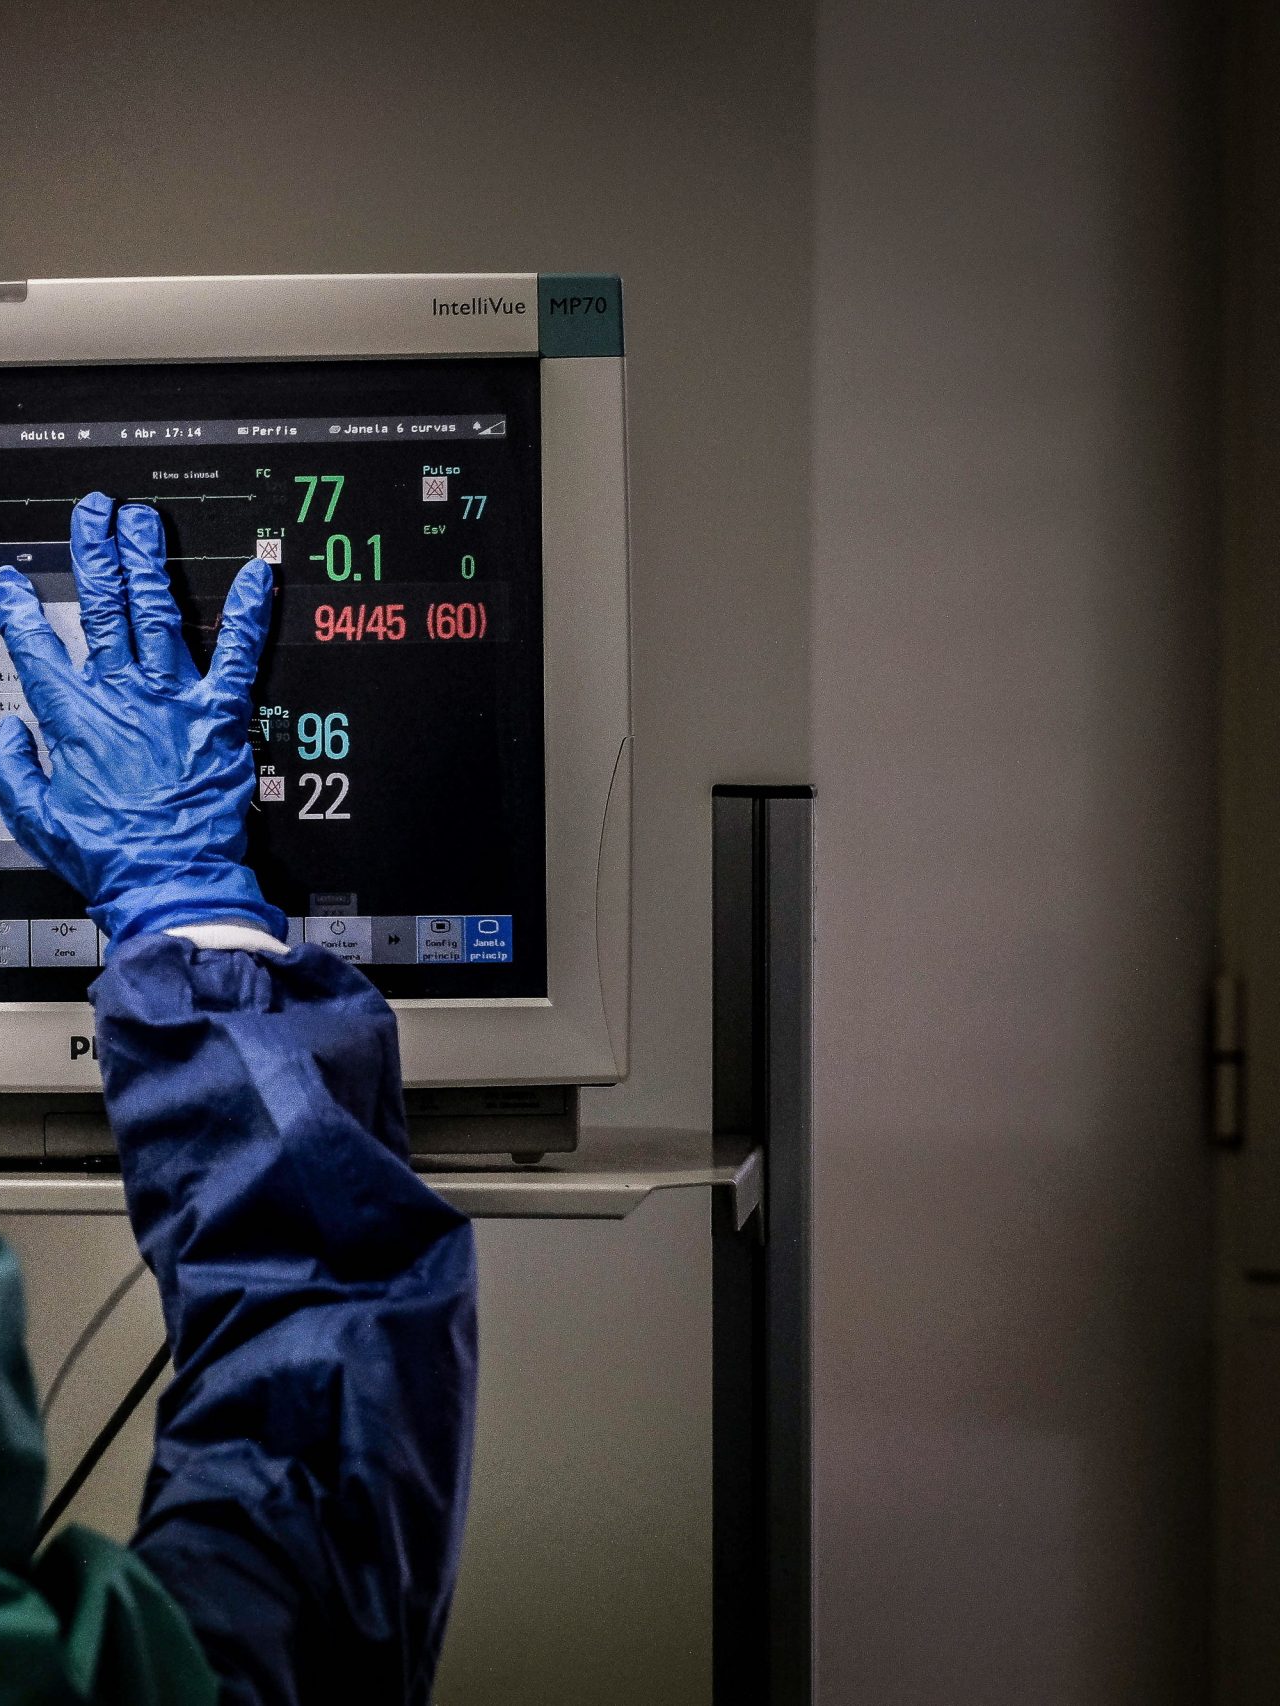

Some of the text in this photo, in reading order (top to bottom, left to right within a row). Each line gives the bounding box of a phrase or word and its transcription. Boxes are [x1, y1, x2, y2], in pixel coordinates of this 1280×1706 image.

[432, 296, 527, 316] IntelliVue
[550, 296, 608, 316] MP70
[120, 427, 202, 439] 6 Abr 17:14
[252, 426, 298, 436] Perfis
[344, 422, 457, 434] Janela 6 curvas
[20, 428, 65, 442] Adulto
[152, 470, 219, 480] Ritmo sinusal
[256, 468, 271, 478] FC
[422, 465, 461, 475] Pulso
[294, 475, 345, 523] 77
[460, 495, 487, 520] 77
[423, 525, 446, 535] EsV
[309, 534, 382, 582] -0.1
[461, 554, 476, 580] 0
[314, 602, 488, 642] 94/45 (60)
[297, 712, 350, 760] 96
[260, 765, 276, 775] FR
[298, 772, 351, 820] 22
[473, 939, 506, 947] Janela
[54, 948, 76, 958] Zero
[470, 952, 508, 962] princip
